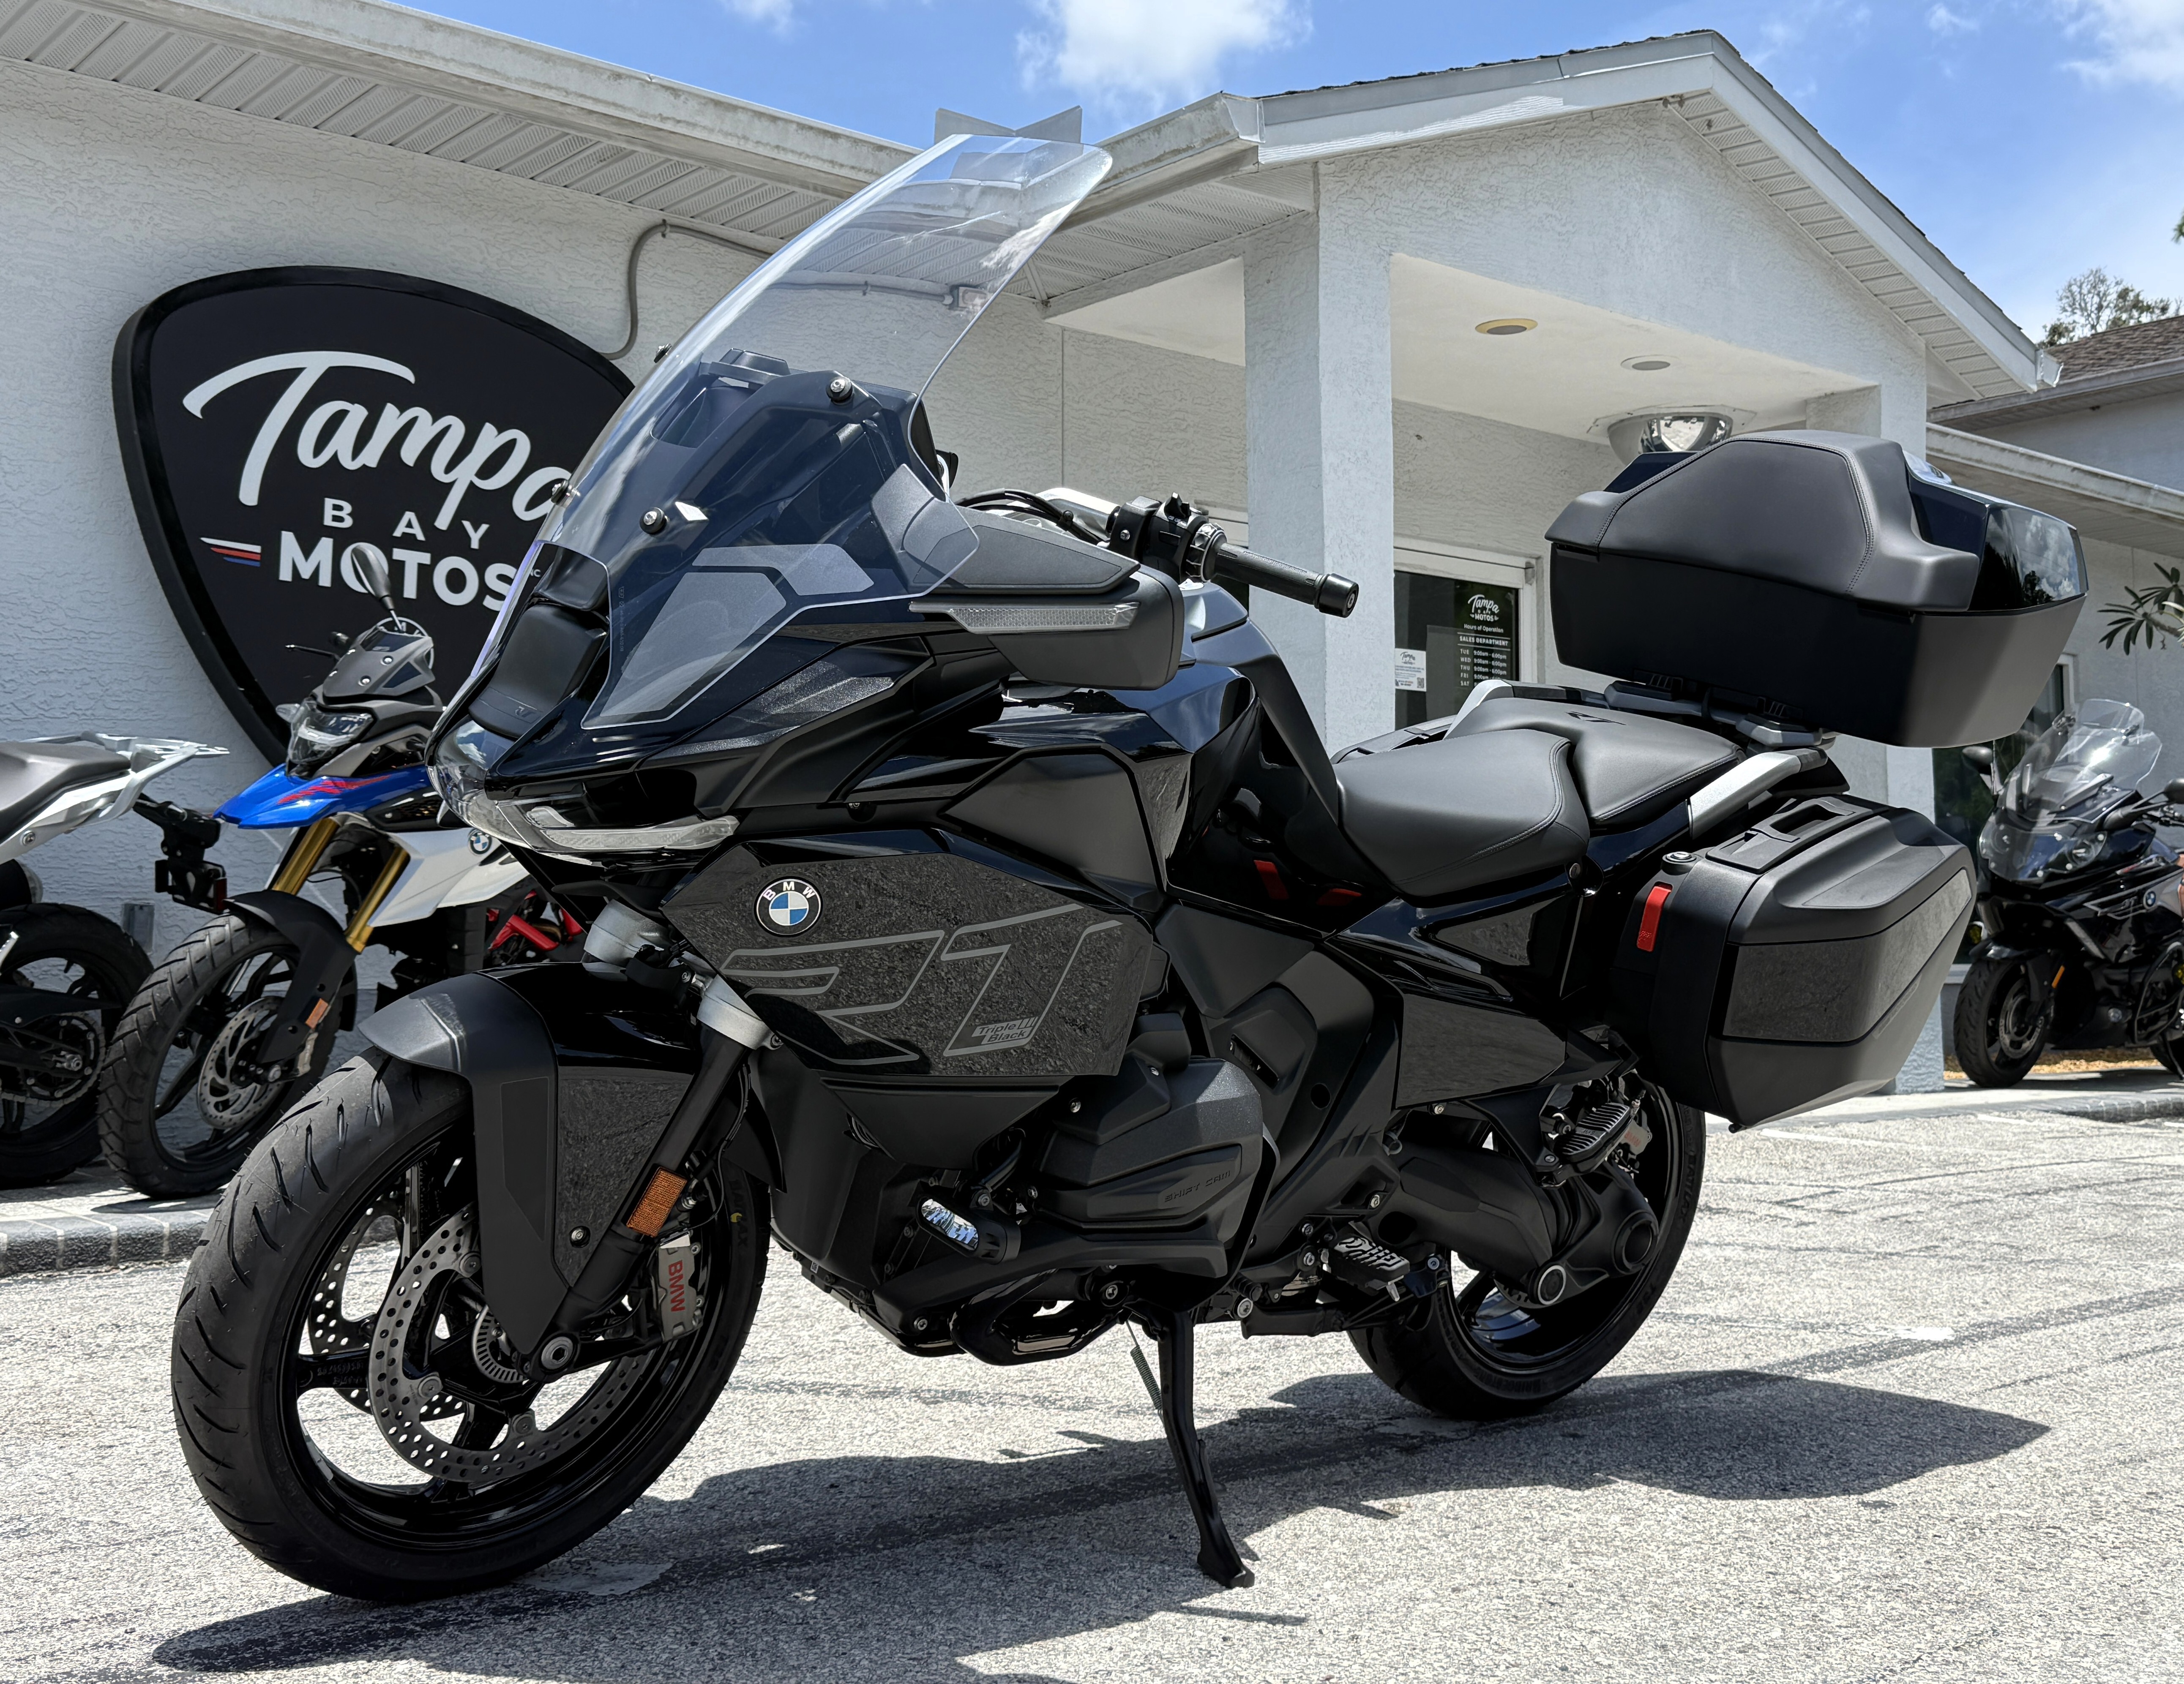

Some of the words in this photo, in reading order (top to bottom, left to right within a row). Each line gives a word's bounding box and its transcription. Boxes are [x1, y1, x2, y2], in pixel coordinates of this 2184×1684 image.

[1468, 594, 1500, 613] Tampa
[1475, 613, 1494, 622] MOTOS
[1476, 638, 1508, 646] DEPARTMENT
[763, 881, 816, 901] BMW
[979, 1023, 1016, 1035] Triple
[987, 1030, 1026, 1043] Black
[1164, 1183, 1200, 1202] SHIFT
[1205, 1170, 1230, 1186] CAM
[668, 1260, 685, 1312] BMW
